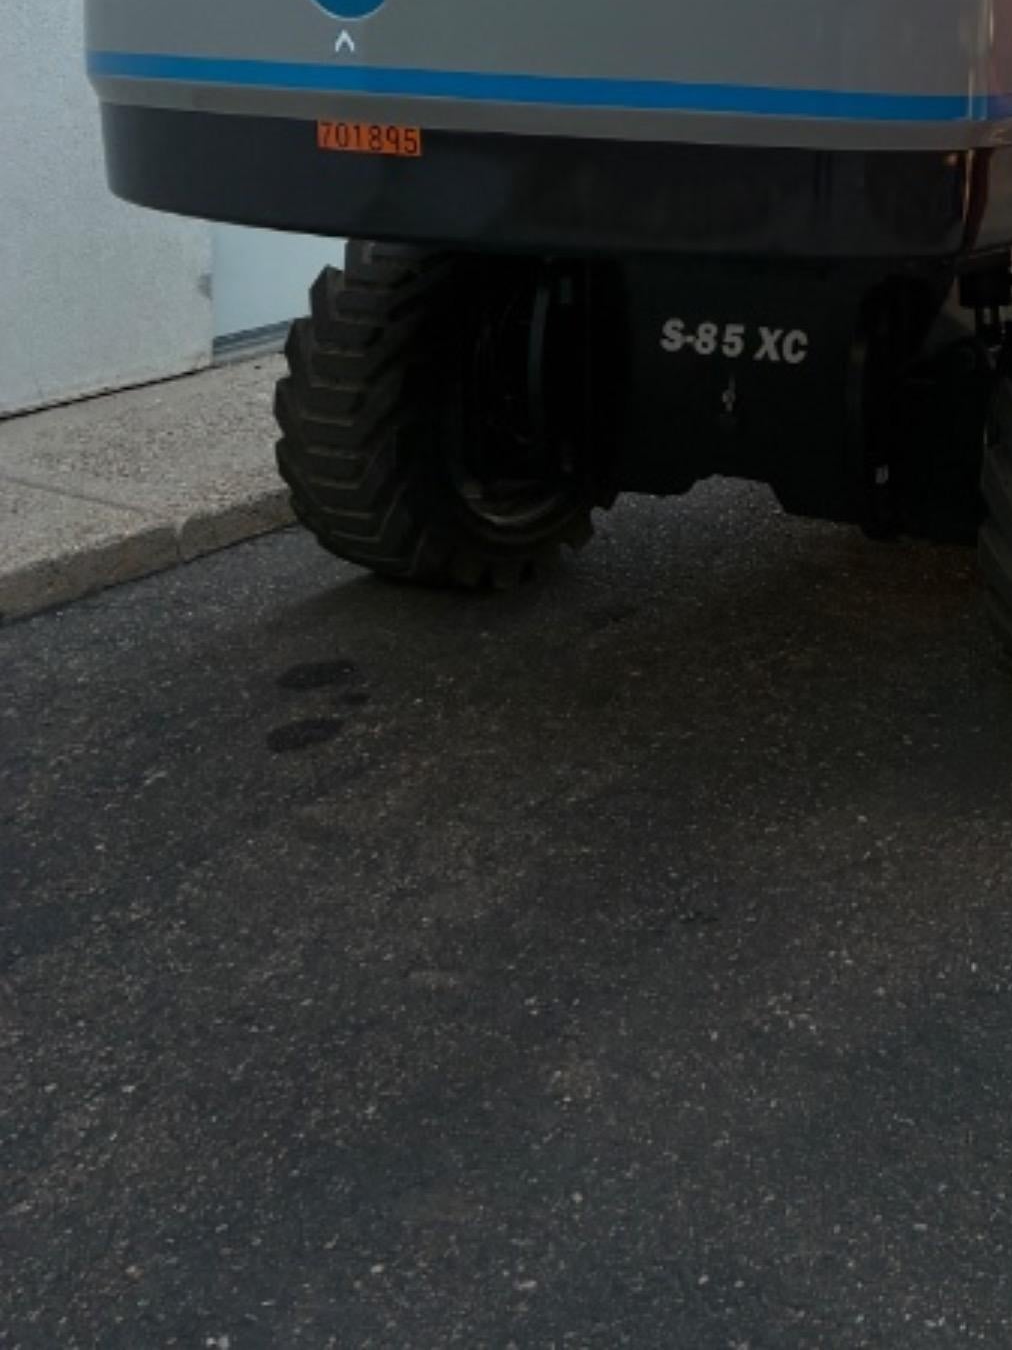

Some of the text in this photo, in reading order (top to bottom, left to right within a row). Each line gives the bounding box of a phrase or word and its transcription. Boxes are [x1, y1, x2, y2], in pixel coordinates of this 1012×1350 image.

[320, 121, 418, 155] 701895
[659, 317, 808, 364] S-85 XC
